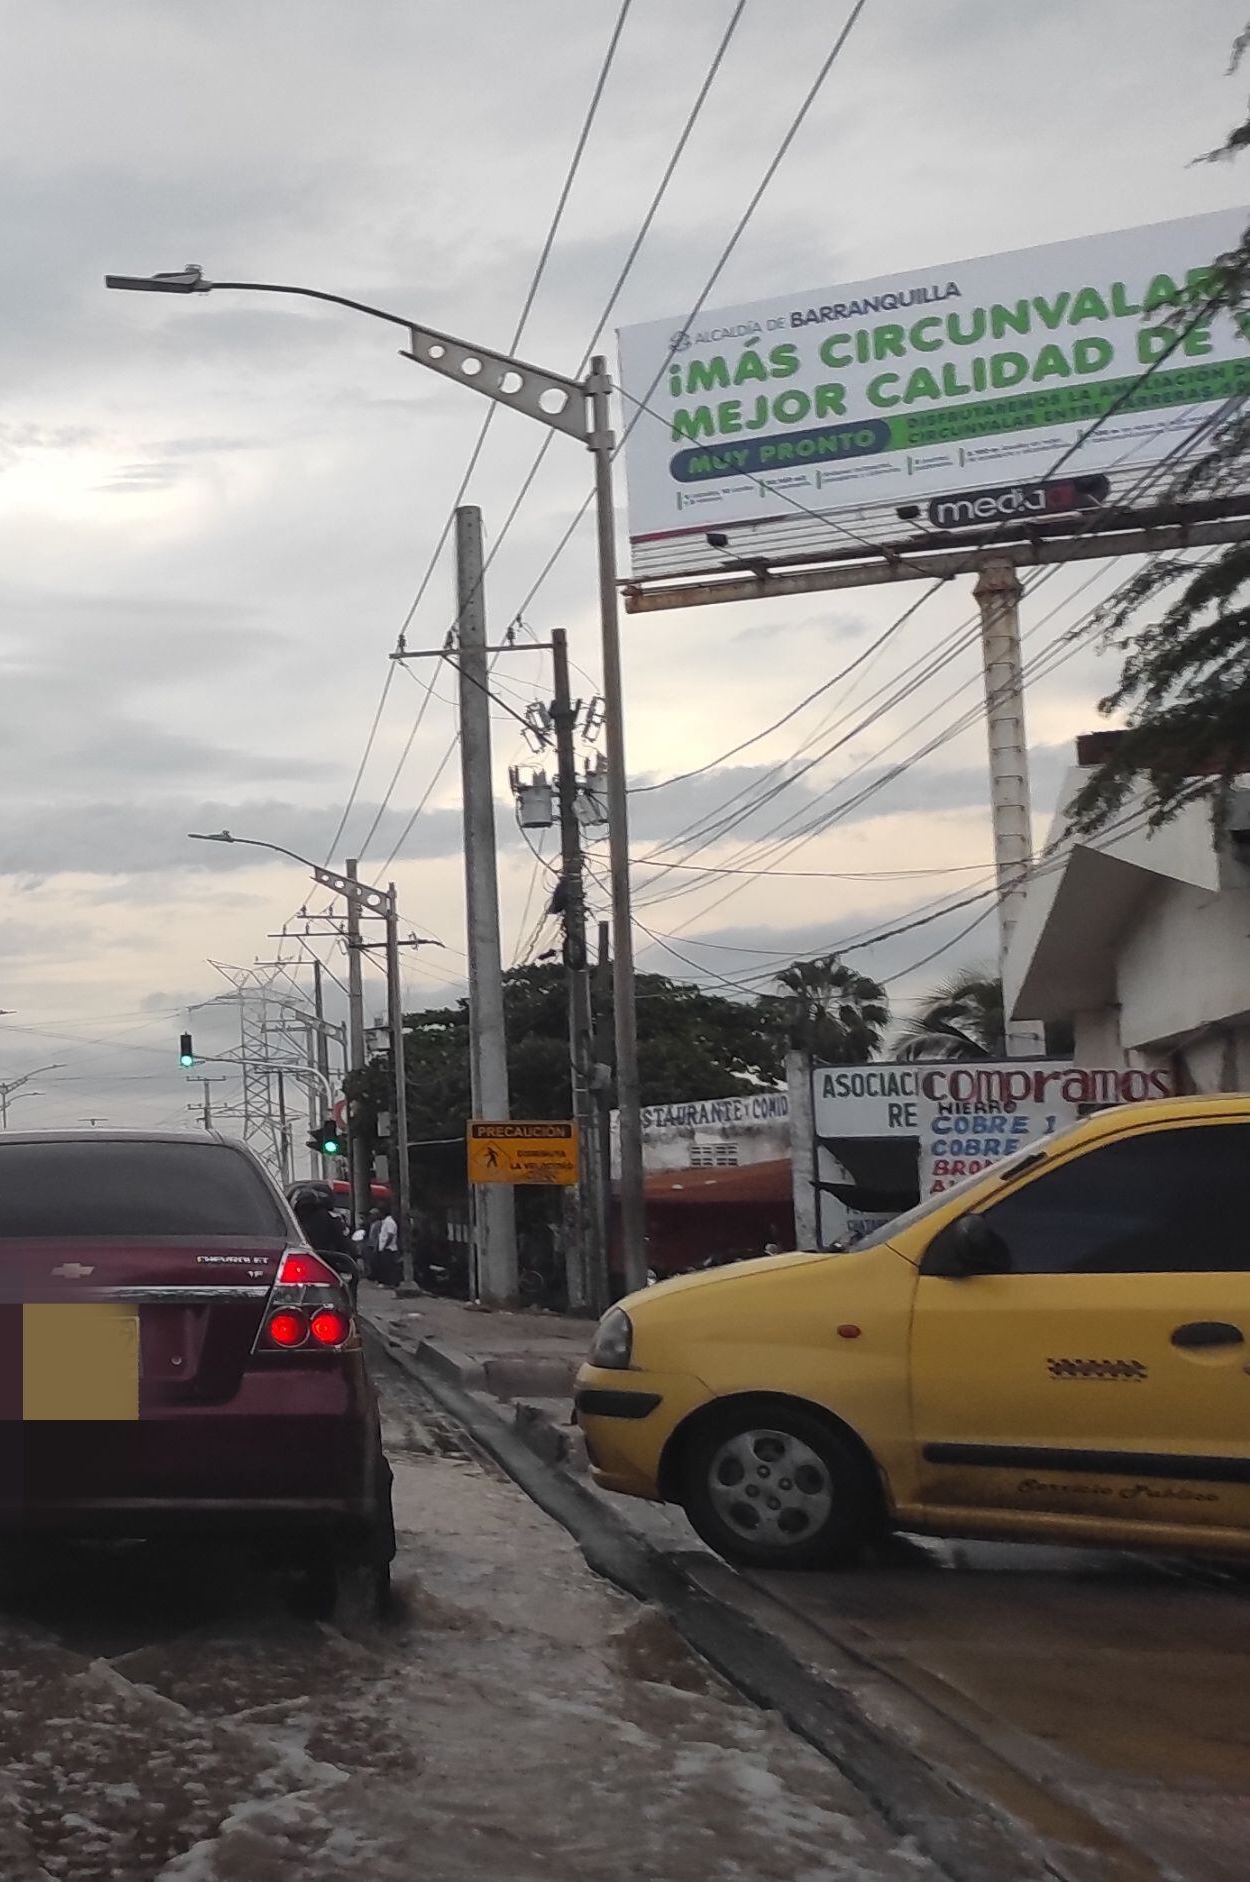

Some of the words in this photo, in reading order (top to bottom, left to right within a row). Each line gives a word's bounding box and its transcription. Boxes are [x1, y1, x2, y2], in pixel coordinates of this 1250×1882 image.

[695, 319, 762, 344] ALCALDÍA
[766, 316, 787, 332] DE
[790, 281, 962, 329] BARRANQUILLA
[669, 336, 800, 397] ¡MÁS
[671, 382, 846, 442] MEJOR
[866, 336, 1114, 408] CALIDAD
[1137, 316, 1213, 365] DE
[1100, 366, 1226, 397] AMLIACIÓN
[688, 448, 749, 475] MUY
[759, 428, 876, 463] PRONTO
[888, 1102, 918, 1128] RE
[937, 1100, 1017, 1116] HIERRO
[931, 1115, 1030, 1135] COBRE
[931, 1138, 1021, 1157] COBRE
